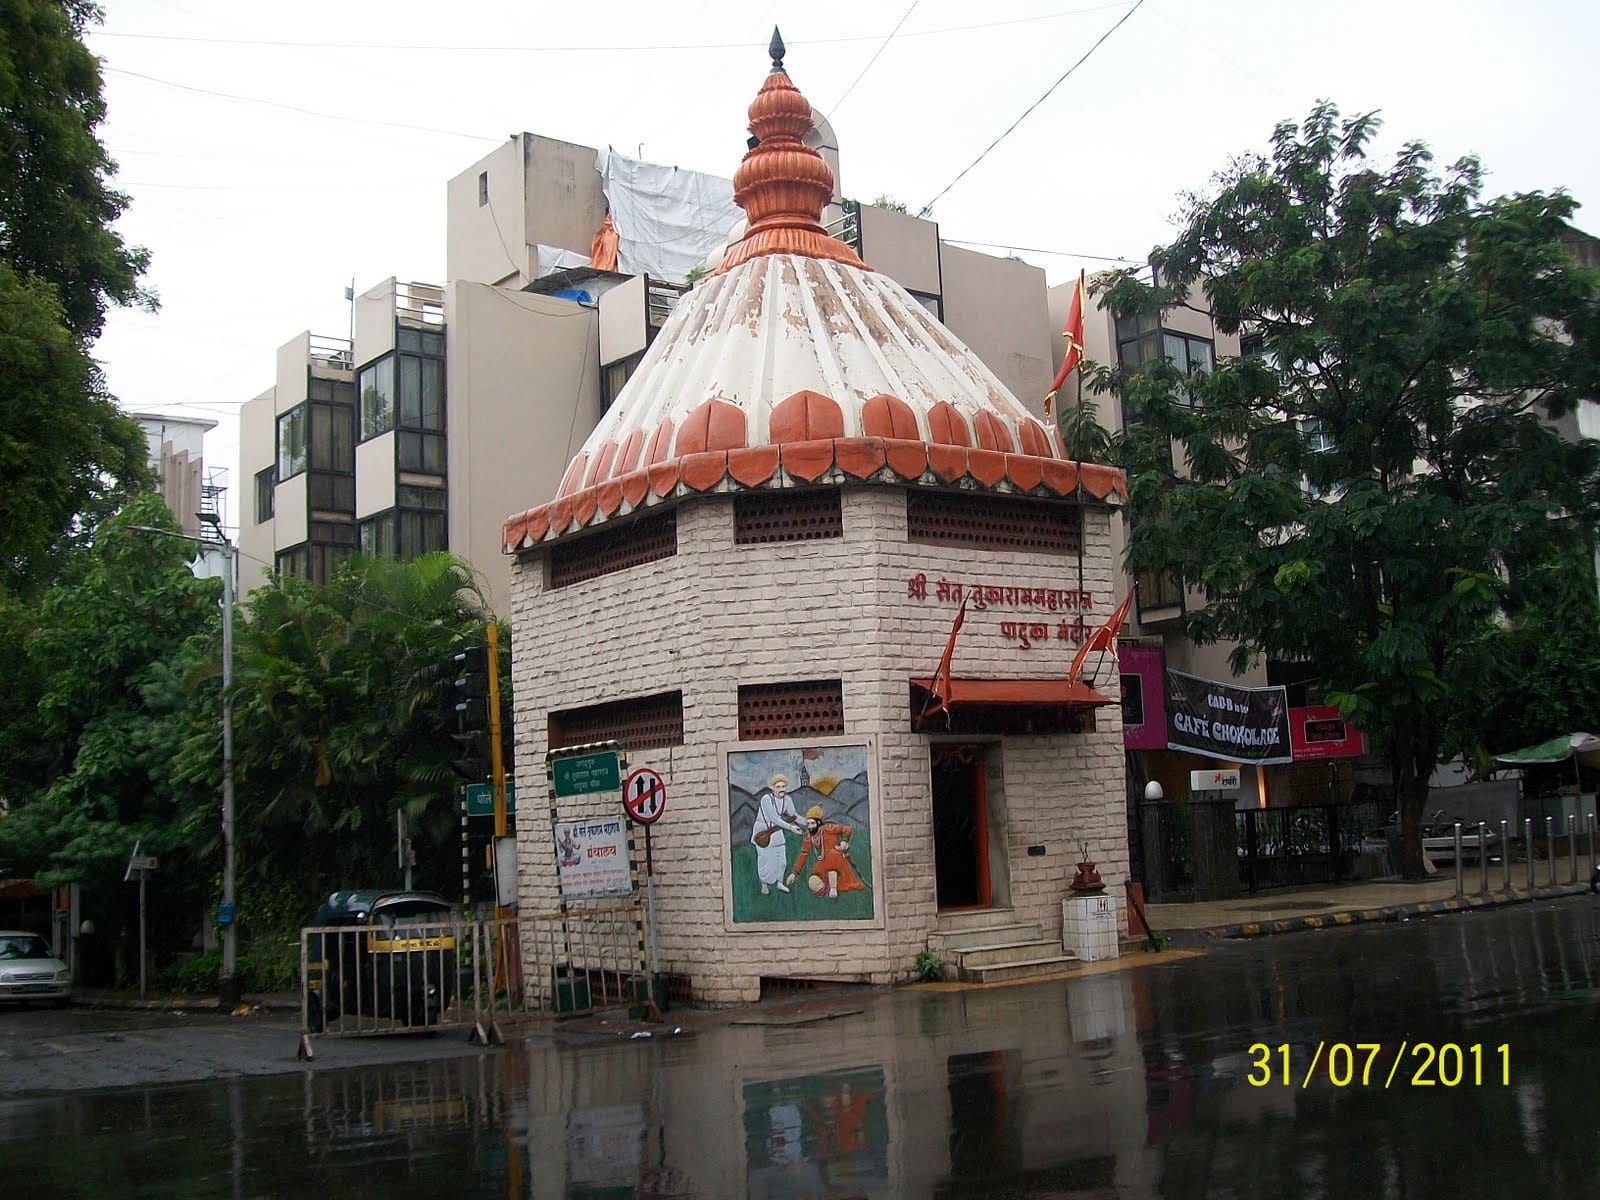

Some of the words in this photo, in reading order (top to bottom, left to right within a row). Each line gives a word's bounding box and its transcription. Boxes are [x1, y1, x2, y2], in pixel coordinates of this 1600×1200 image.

[908, 573, 928, 601] श्री
[936, 576, 963, 602] संत
[1001, 621, 1049, 649] पादुका
[1212, 721, 1280, 748] CHOKOLADE
[587, 844, 617, 858] ग्रंथालय
